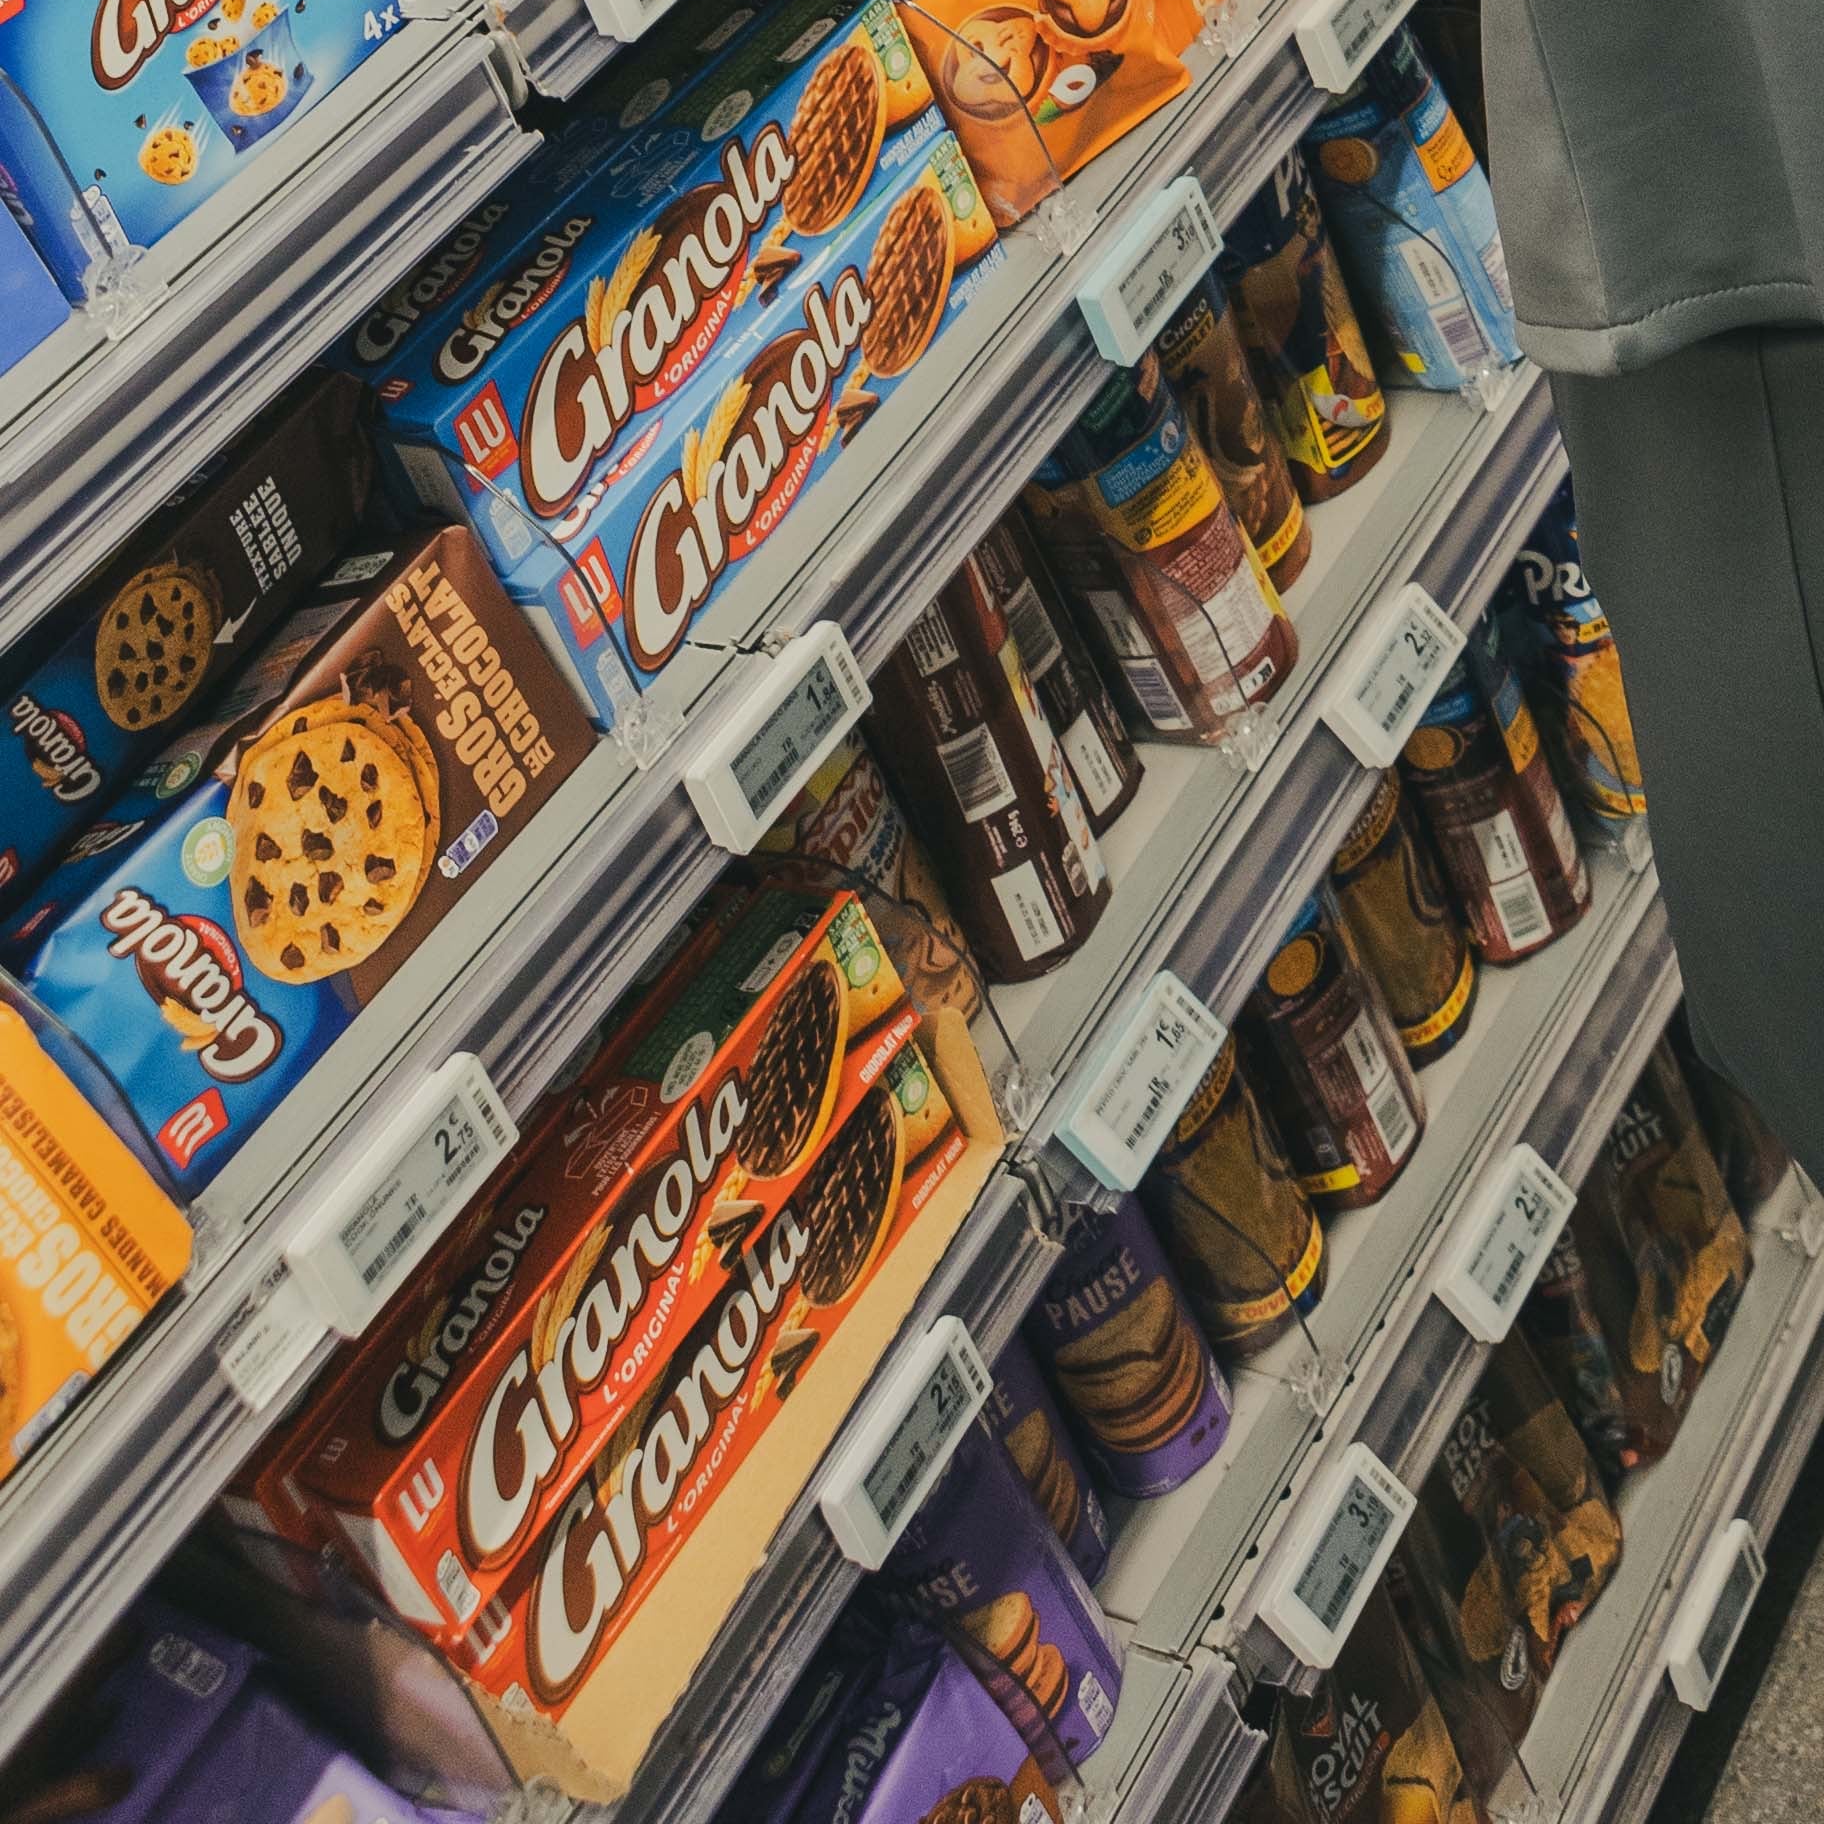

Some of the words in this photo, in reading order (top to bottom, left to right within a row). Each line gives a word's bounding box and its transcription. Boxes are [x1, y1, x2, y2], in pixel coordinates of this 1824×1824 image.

[362, 3, 398, 43] 4x
[438, 215, 593, 380] Granola
[531, 130, 795, 502] Granola
[653, 287, 732, 398] L'ORIGINAL
[459, 398, 507, 464] LU
[633, 273, 873, 657] Granola
[257, 475, 303, 566] UNIQUE
[744, 432, 818, 548] L'ORIGINAL
[386, 582, 468, 702] ÉCLATS
[563, 554, 611, 623] LU
[408, 560, 541, 753] CHOCOLAT
[11, 695, 101, 801] Granola
[436, 691, 527, 818] GROS
[526, 735, 556, 778] DE
[106, 889, 277, 1077] Granola
[859, 1031, 897, 1085] CHOCOLAT
[169, 1101, 214, 1158] LU
[911, 1163, 945, 1210] CHOCOLAT
[381, 1204, 545, 1439] Granola
[467, 1080, 749, 1554] Granola
[602, 1261, 685, 1405] L'ORIGINAL
[1046, 1247, 1145, 1331] PAUSE
[398, 1456, 445, 1533] LU
[538, 1209, 812, 1685] Granola
[665, 1390, 748, 1533] L'ORIGINAL
